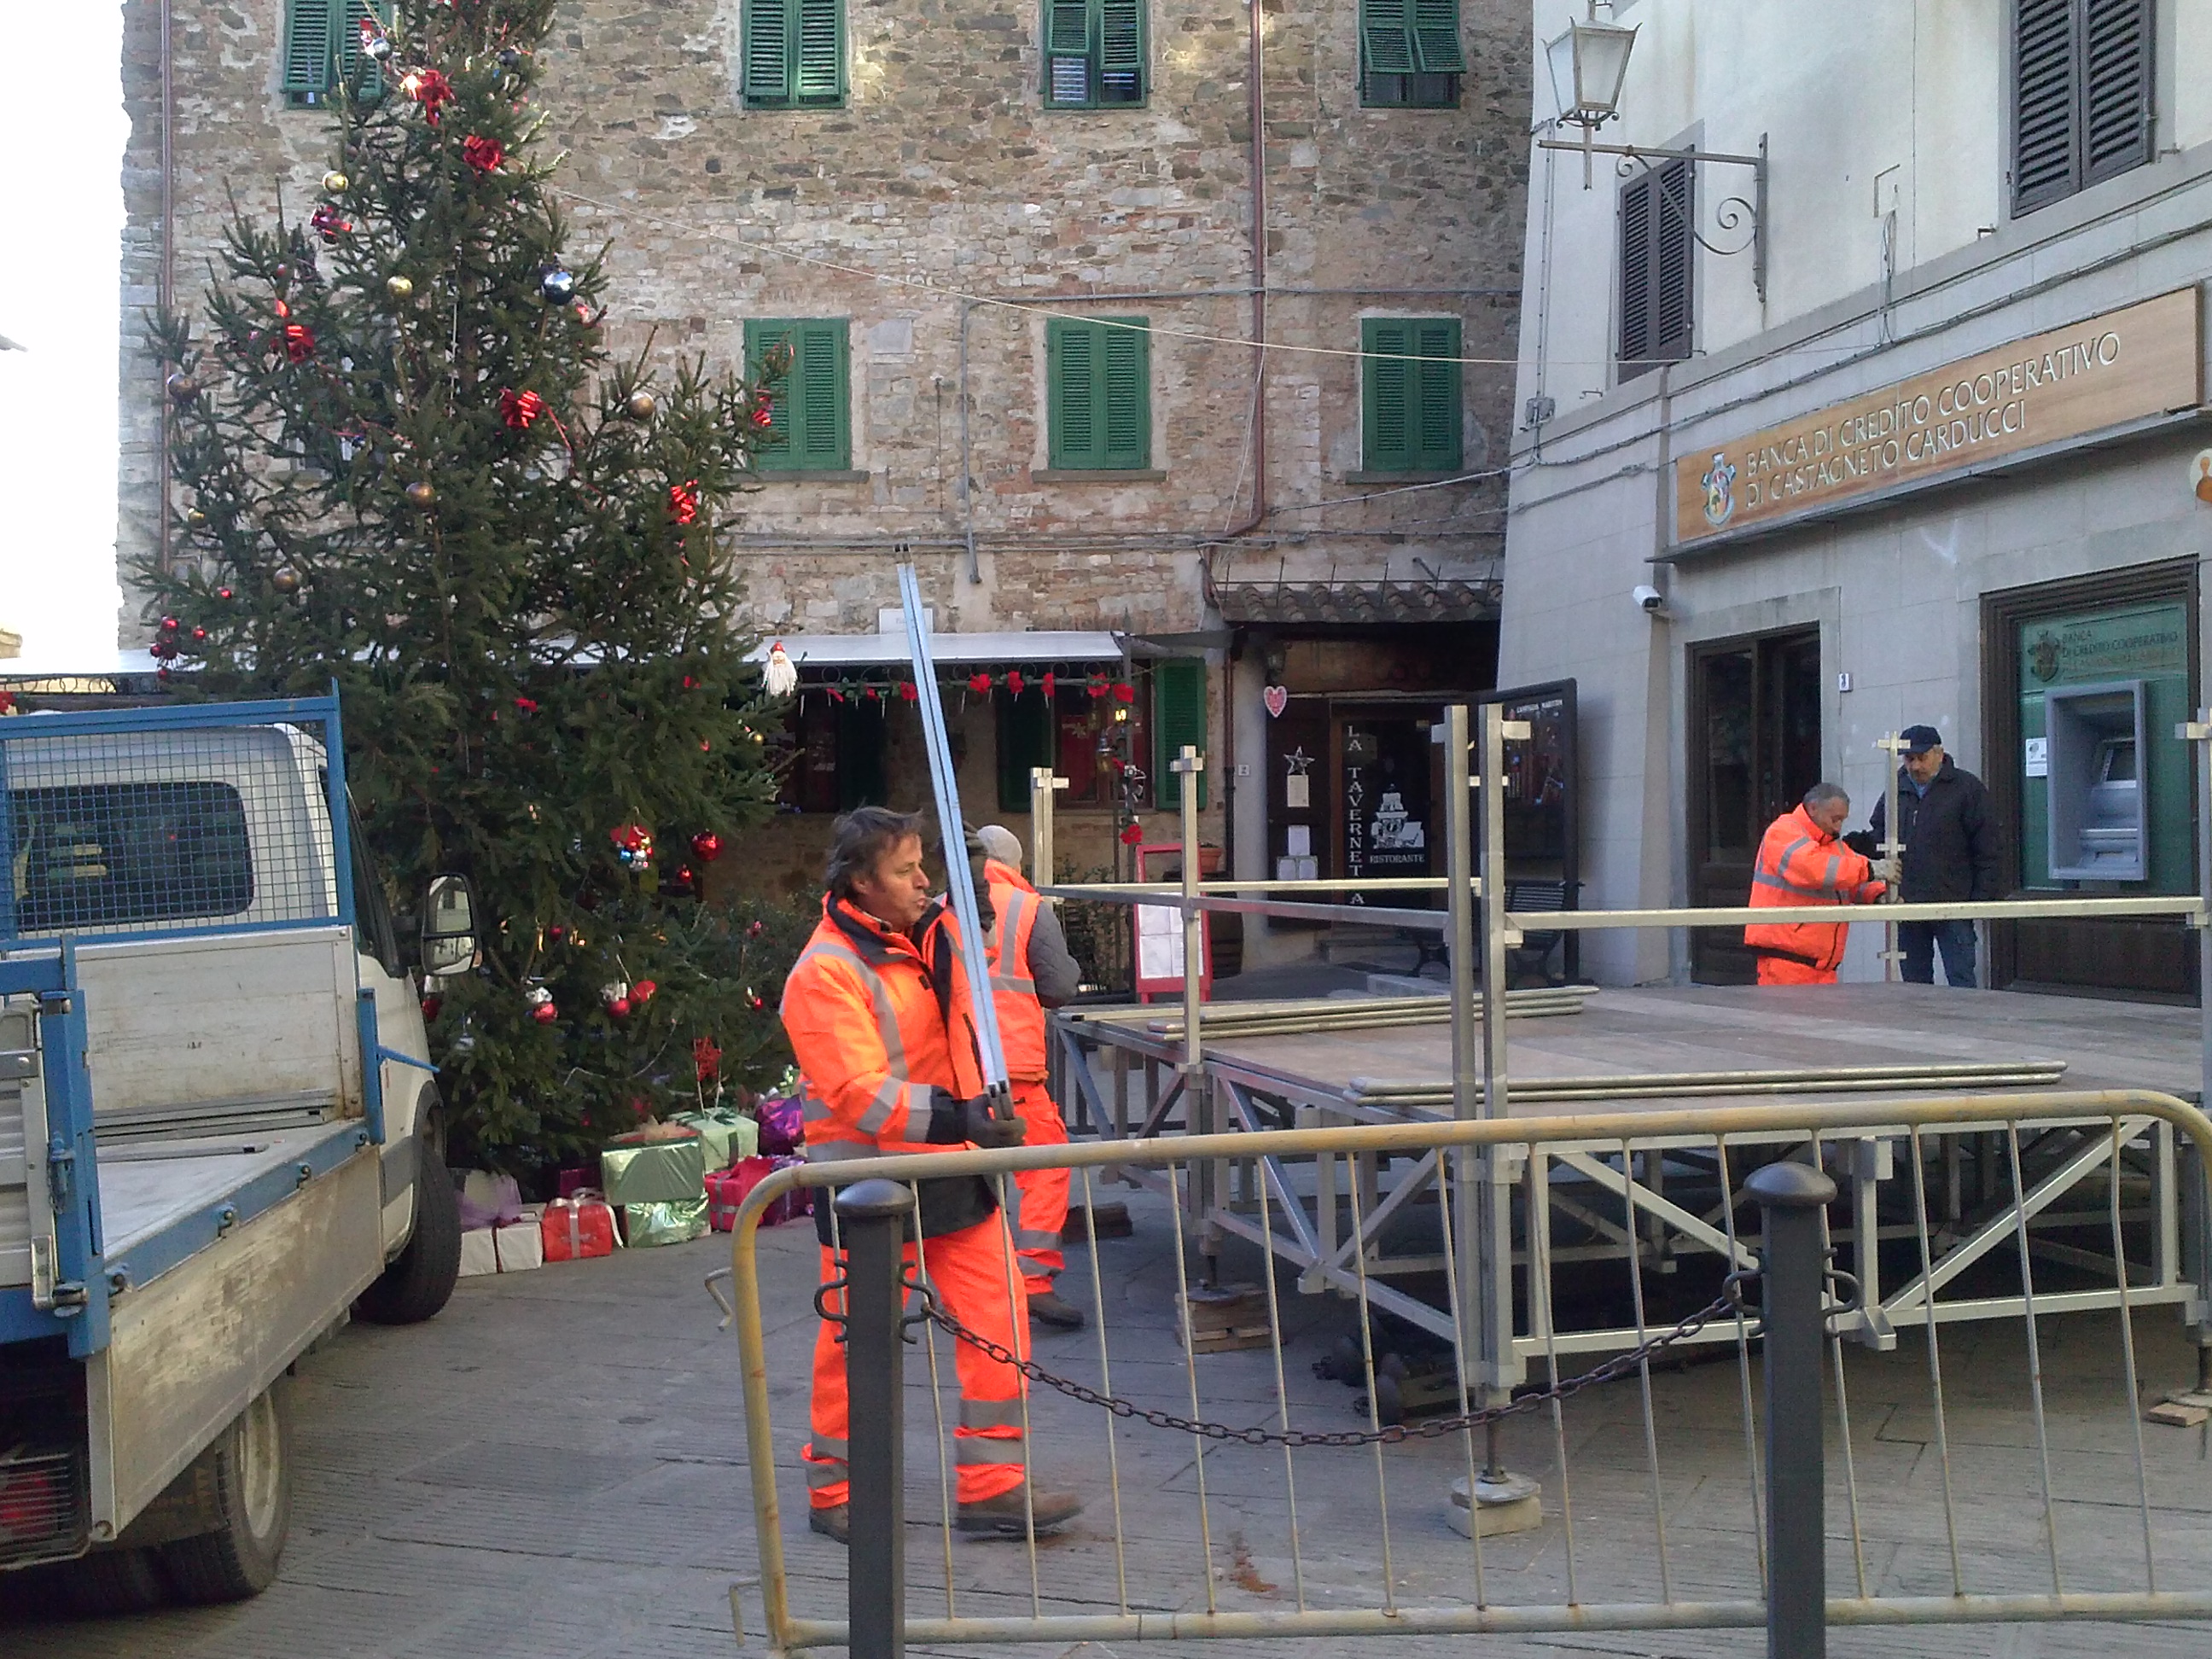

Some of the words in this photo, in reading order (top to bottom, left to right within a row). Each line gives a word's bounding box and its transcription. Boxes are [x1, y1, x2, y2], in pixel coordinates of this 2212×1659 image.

[1745, 436, 1808, 477] BANCA
[1813, 427, 1833, 456] DI
[1840, 395, 1930, 446] CREDITO
[1938, 332, 2121, 416] COOPERATIVO
[1746, 479, 1763, 509] DI
[1770, 439, 1899, 500] CASTAGNETO
[1906, 399, 2025, 461] CARDUCCI
[2062, 630, 2092, 643] BANCA
[1348, 725, 1362, 751] LA
[1348, 767, 1365, 905] TAVERNETA
[1370, 853, 1424, 864] RISTORANTE
